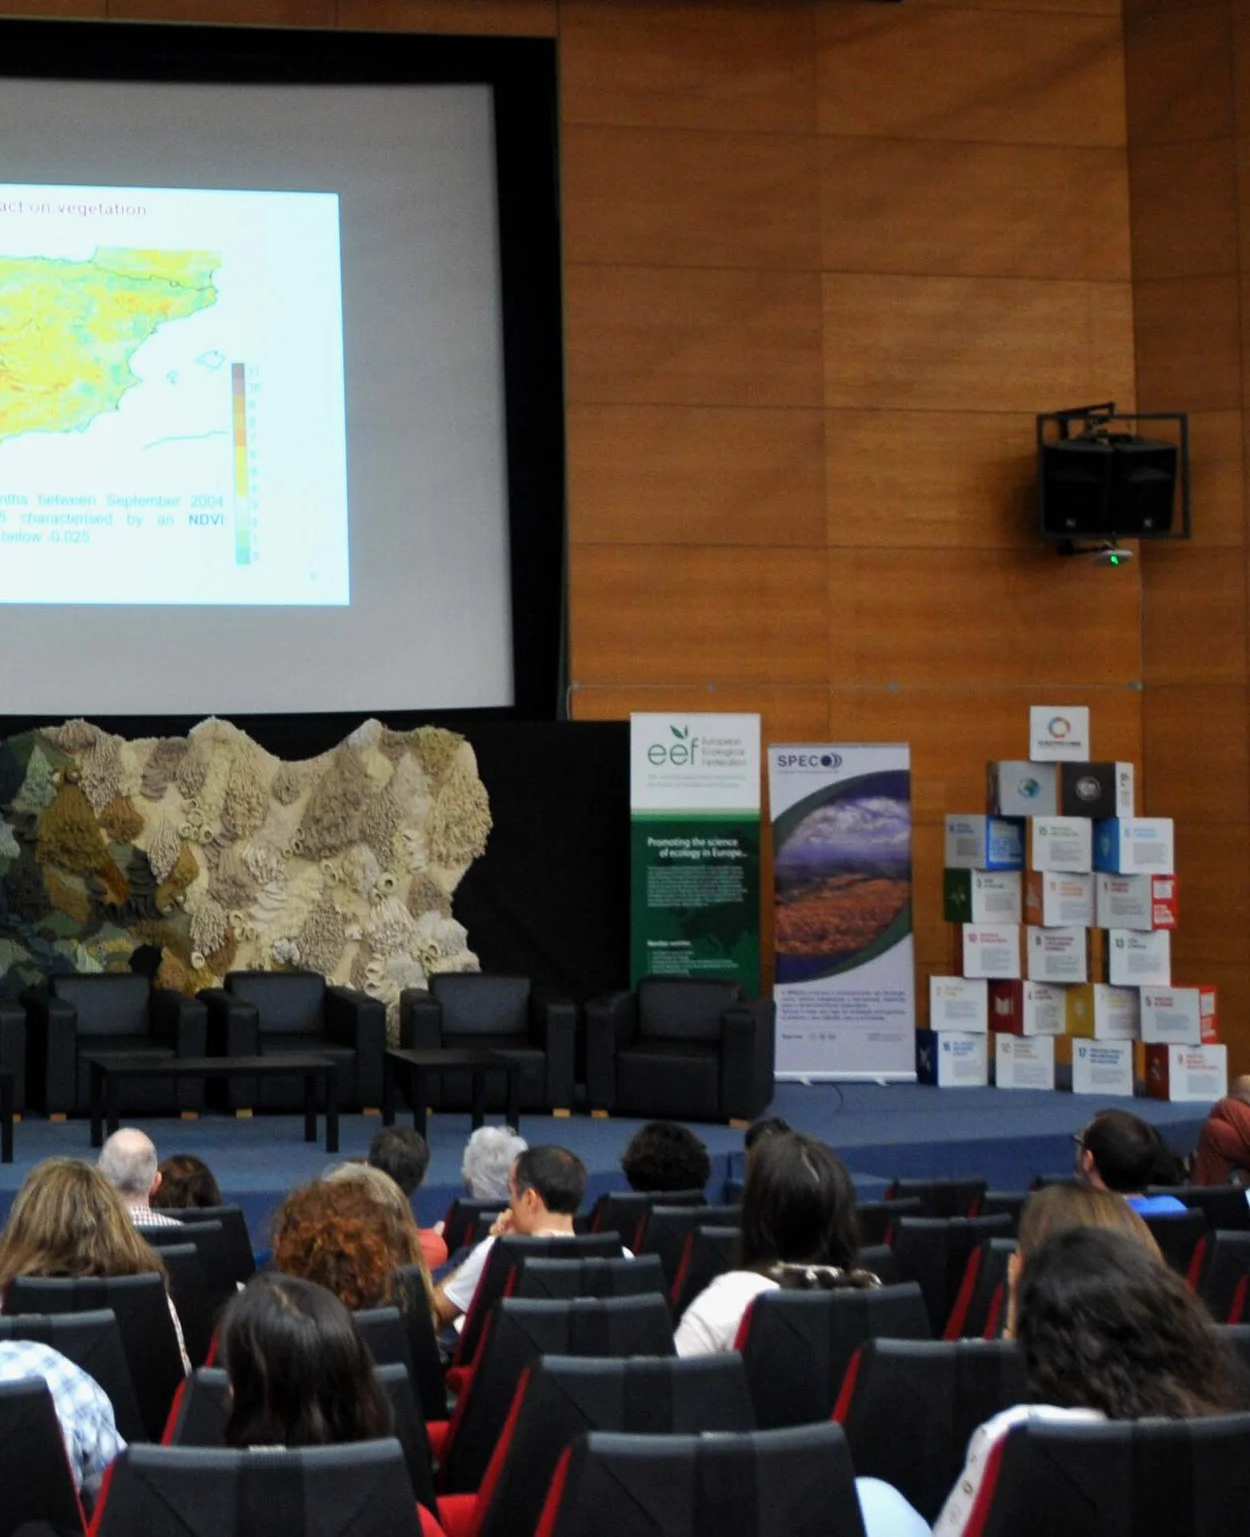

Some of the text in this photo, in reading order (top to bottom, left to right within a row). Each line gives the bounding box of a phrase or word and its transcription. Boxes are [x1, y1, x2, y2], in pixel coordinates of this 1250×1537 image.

[30, 202, 50, 213] on
[58, 201, 147, 217] vegetation
[38, 494, 96, 506] between
[106, 494, 180, 507] September
[190, 495, 223, 507] 2004
[21, 512, 112, 525] characterised
[127, 514, 143, 529] by
[157, 516, 174, 526] an
[189, 514, 224, 526] NDVI
[2, 531, 41, 543] below
[648, 737, 699, 766] eef
[648, 837, 738, 848] Promoting the science
[659, 848, 668, 858] of
[669, 849, 701, 860] ecology
[702, 848, 710, 857] in
